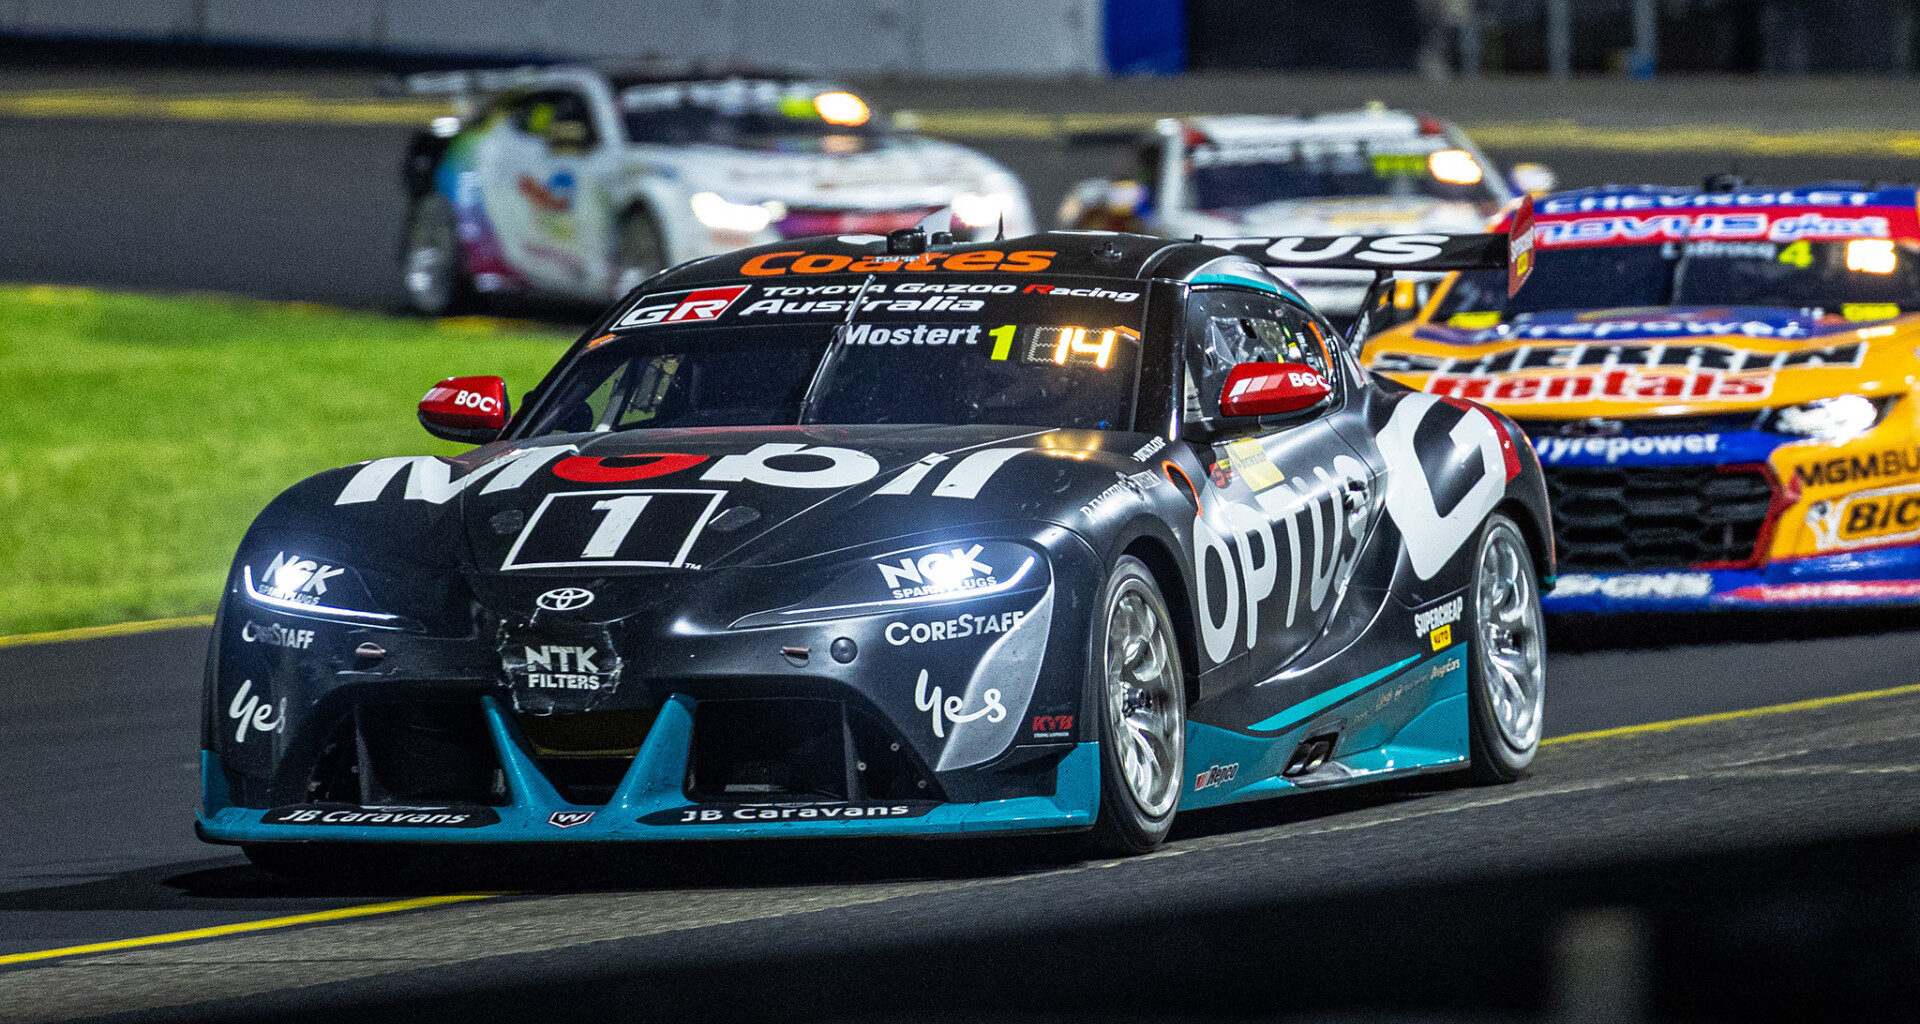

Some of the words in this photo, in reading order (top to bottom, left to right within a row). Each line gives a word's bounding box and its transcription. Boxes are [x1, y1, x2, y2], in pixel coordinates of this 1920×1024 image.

[740, 250, 1057, 277] Coates
[1779, 239, 1813, 268] 4
[763, 283, 886, 297] TOYOTA
[894, 282, 1017, 295] GAZOO
[1022, 284, 1140, 302] Racing
[620, 299, 729, 328] GR
[845, 323, 981, 346] Mostert
[988, 324, 1018, 361] 1
[1053, 325, 1117, 369] 14
[1288, 372, 1332, 391] BOC
[454, 390, 496, 412] BOC
[1130, 435, 1166, 462] DUNLOP
[334, 443, 1037, 505] Mobil
[580, 495, 653, 558] 1
[877, 543, 993, 589] NGK
[892, 583, 948, 600] SPAR
[951, 575, 997, 592] LUGS
[1414, 595, 1463, 638] SUPERCHEAP
[525, 644, 599, 673] NTK
[528, 673, 600, 690] FILTERS
[1032, 715, 1073, 732] KYB
[1207, 762, 1239, 788] Repco
[279, 809, 317, 822] JB
[321, 810, 471, 825] Caravans
[681, 809, 724, 822] JB
[732, 804, 909, 820] Caravans
